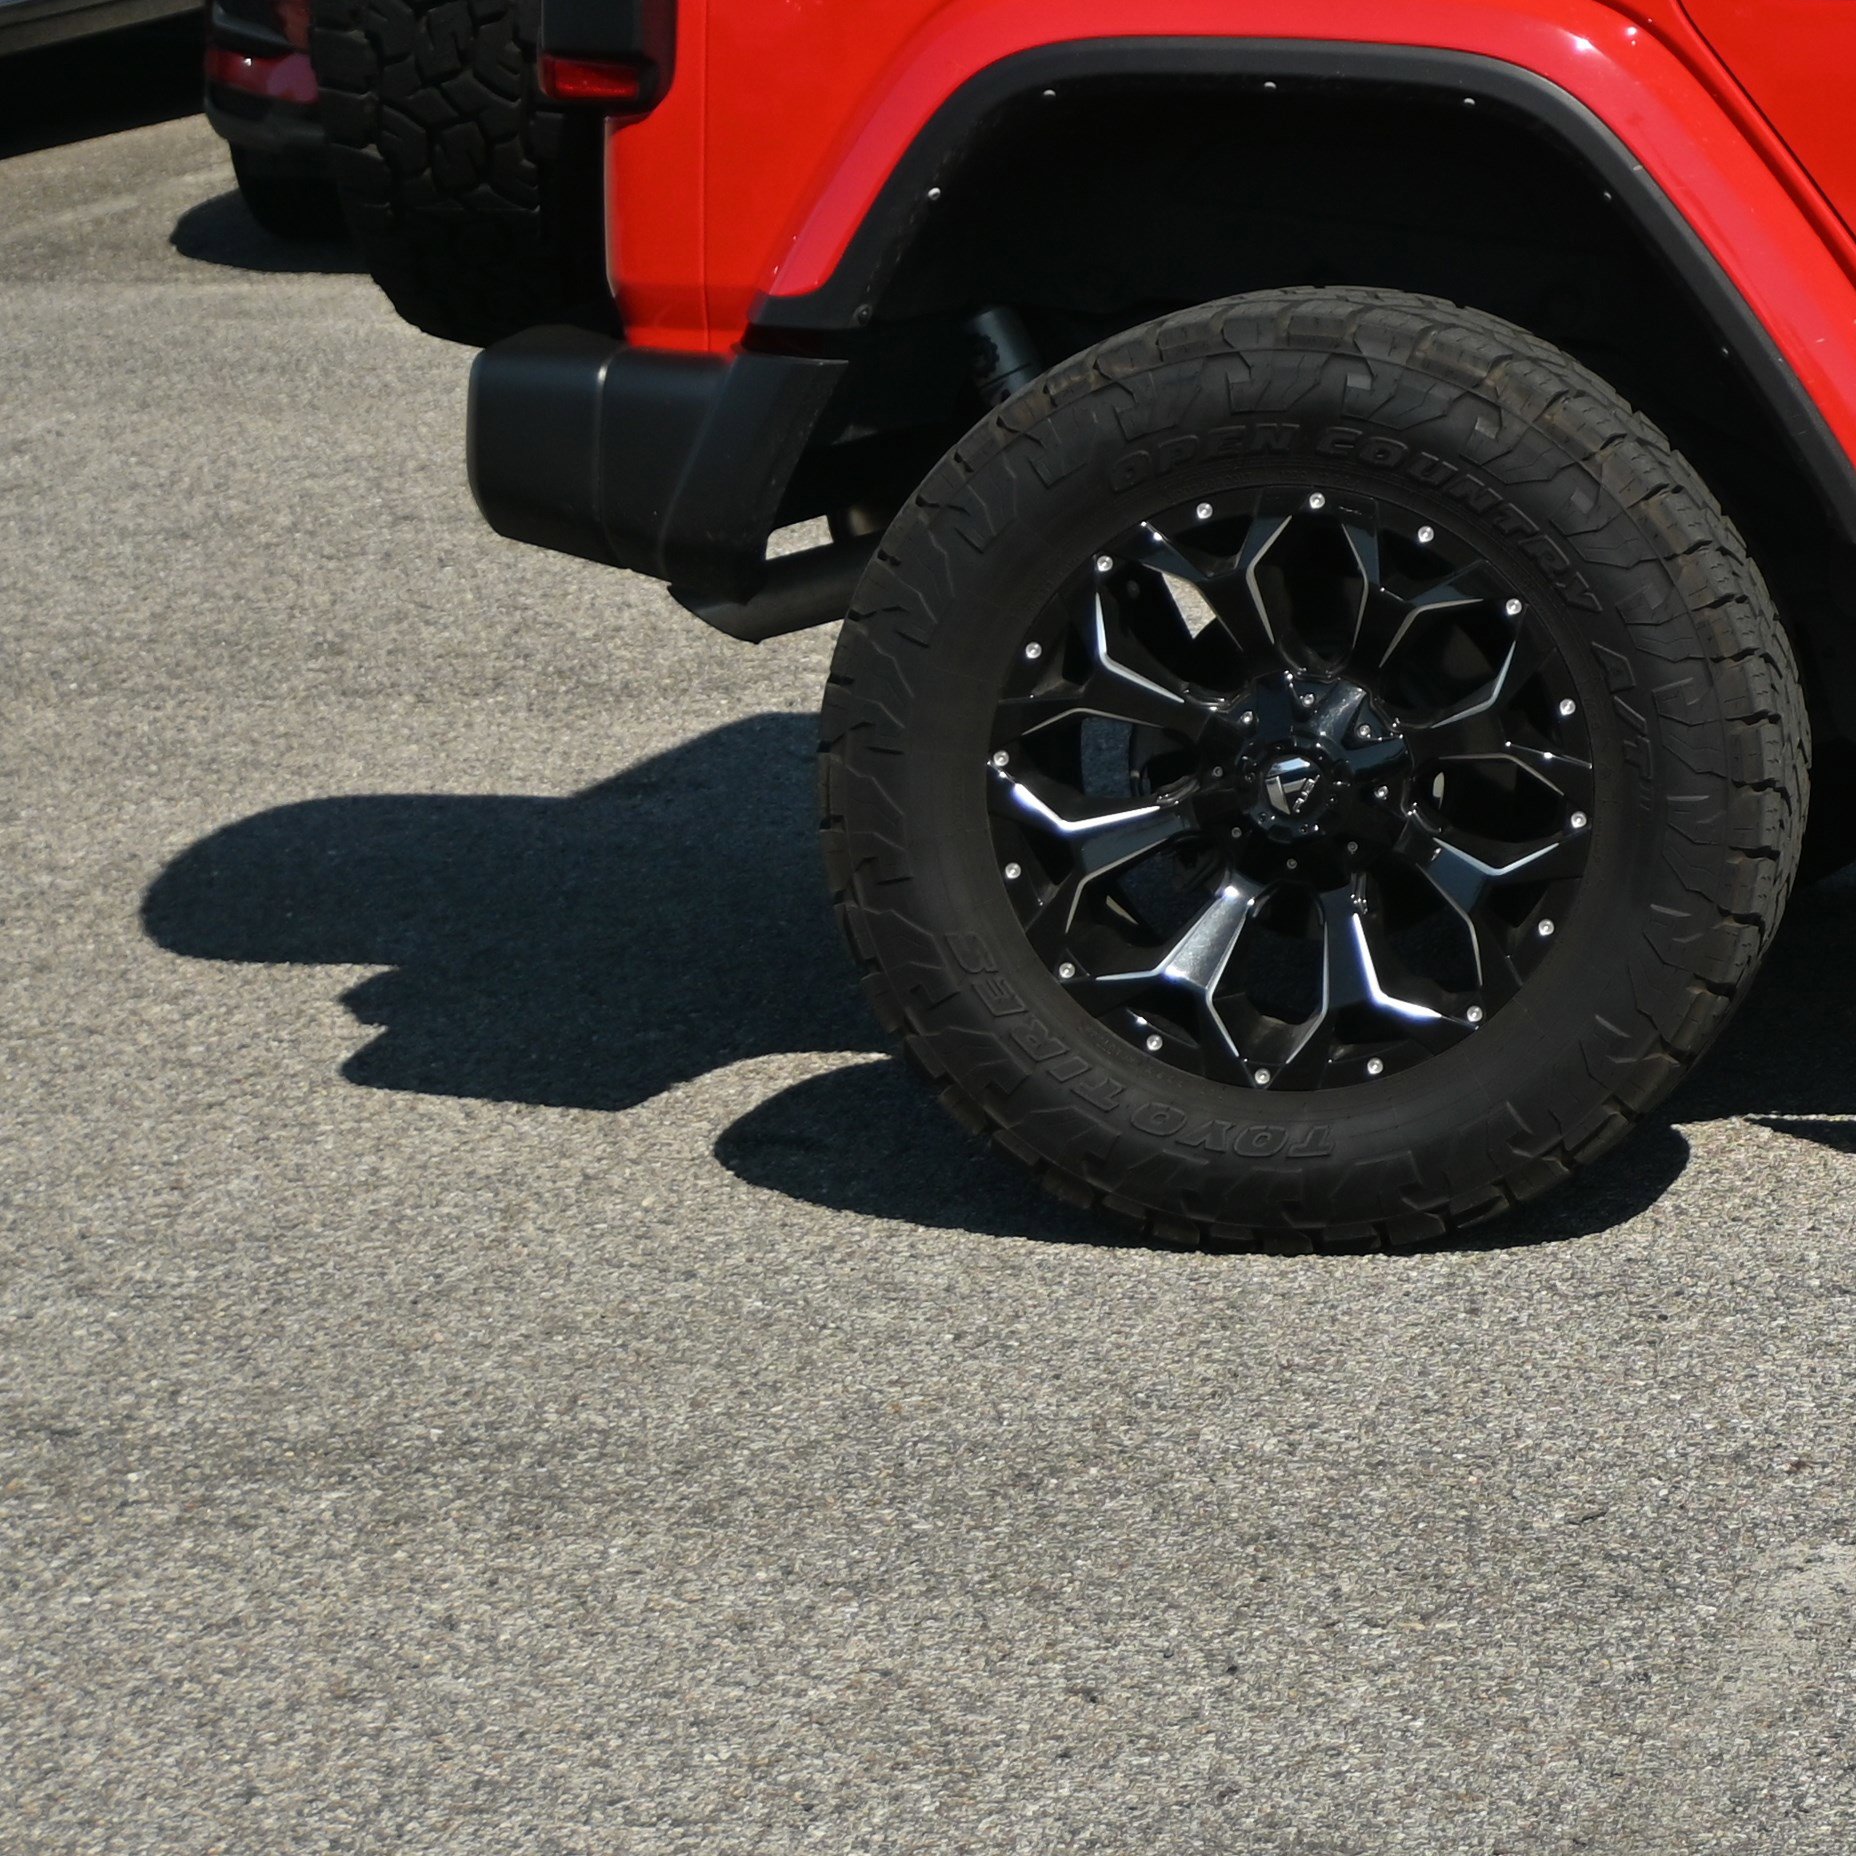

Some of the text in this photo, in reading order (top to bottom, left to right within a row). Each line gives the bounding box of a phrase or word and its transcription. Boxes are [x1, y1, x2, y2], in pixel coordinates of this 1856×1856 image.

[1110, 423, 1301, 492] OPEN
[1315, 425, 1603, 614] COUNTRY
[945, 930, 1127, 1113] TIRES
[1130, 1102, 1336, 1160] TOYO
